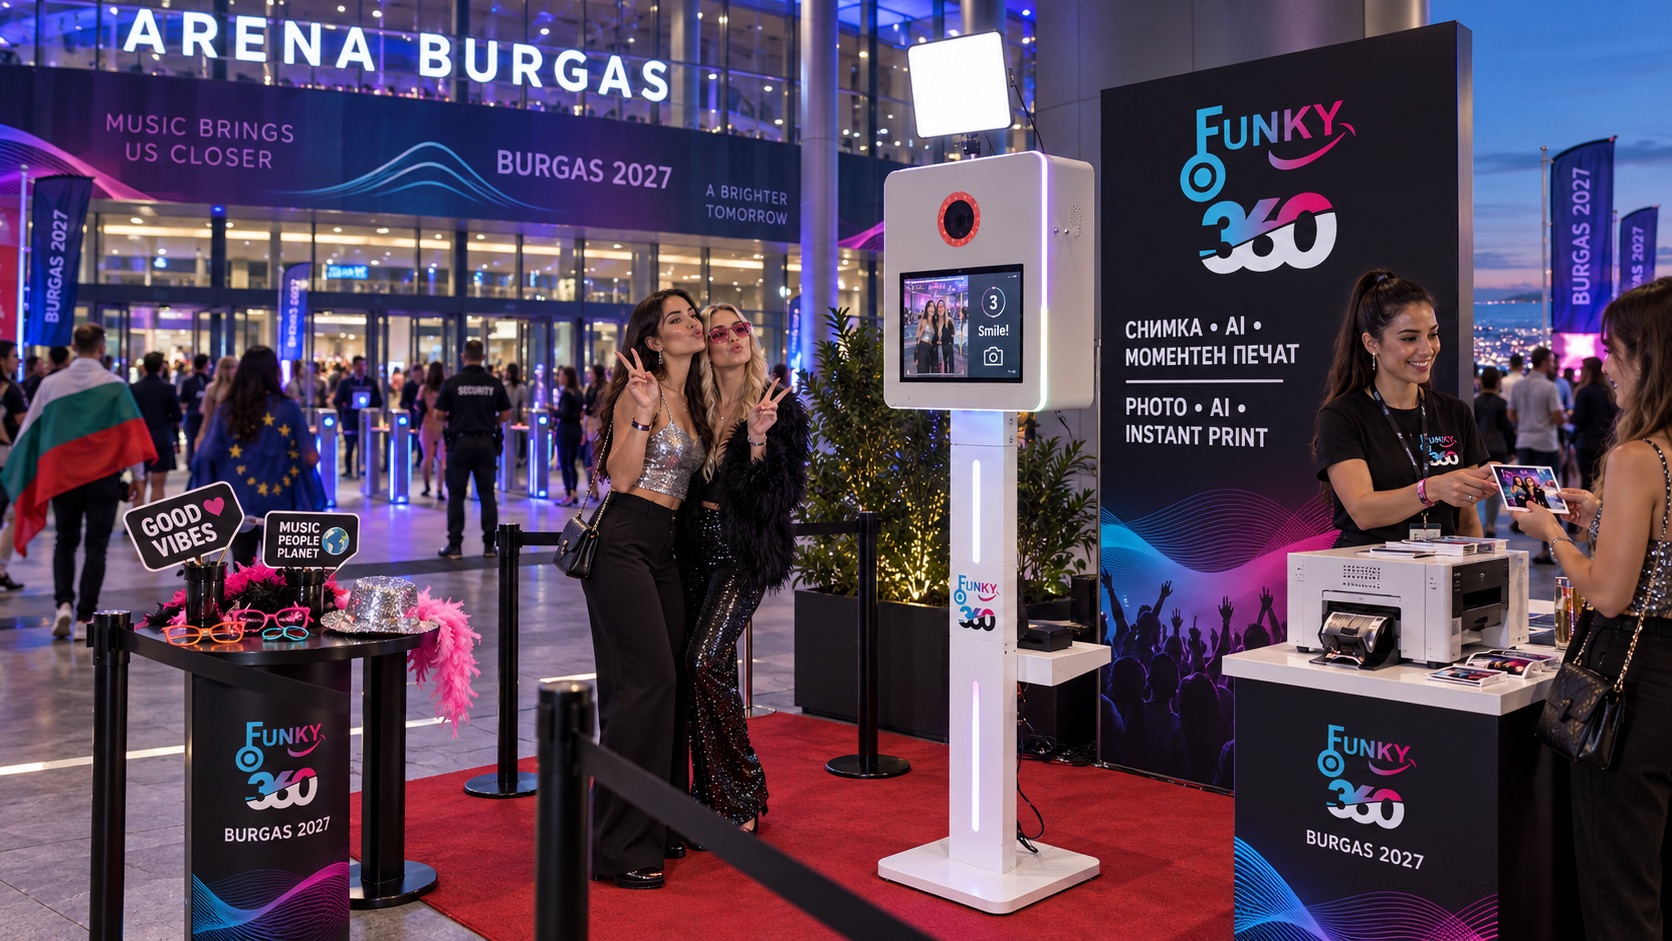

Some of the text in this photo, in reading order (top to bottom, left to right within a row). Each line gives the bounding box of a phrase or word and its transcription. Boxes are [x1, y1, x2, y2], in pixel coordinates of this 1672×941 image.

[123, 9, 668, 102] ARENA BURGAS
[106, 113, 295, 143] MUSIC BRINGS
[125, 142, 272, 169] US CLOSER
[497, 149, 672, 189] BURGAS 2027
[706, 183, 788, 206] A BRIGHTER
[706, 204, 788, 225] TOMORROW
[1199, 192, 1338, 275] 360
[1572, 167, 1590, 305] BURGAS 2027
[1632, 226, 1644, 262] 2027
[45, 209, 69, 323] BURGAS 2027
[989, 294, 998, 310] 3
[978, 324, 1009, 337] Smile!
[1125, 316, 1245, 339] СНИМКА AI
[1125, 343, 1300, 366] МОМЕНТЕН ПЕЧАТ
[457, 385, 495, 396] SECURITY
[1125, 397, 1230, 417] PHOTO AI
[1125, 424, 1268, 447] INSTANT PRINT
[1428, 450, 1459, 466] 360
[141, 503, 201, 537] GOOD
[279, 521, 320, 533] MUSIC
[151, 522, 217, 558] VIBES
[277, 547, 319, 559] PLANET
[278, 534, 320, 546] PEOPLE
[958, 605, 996, 631] 360
[245, 767, 318, 811] 360
[1326, 778, 1405, 830] 360
[224, 816, 331, 842] BURGAS 2027
[1306, 828, 1425, 870] BURGAS 2027
